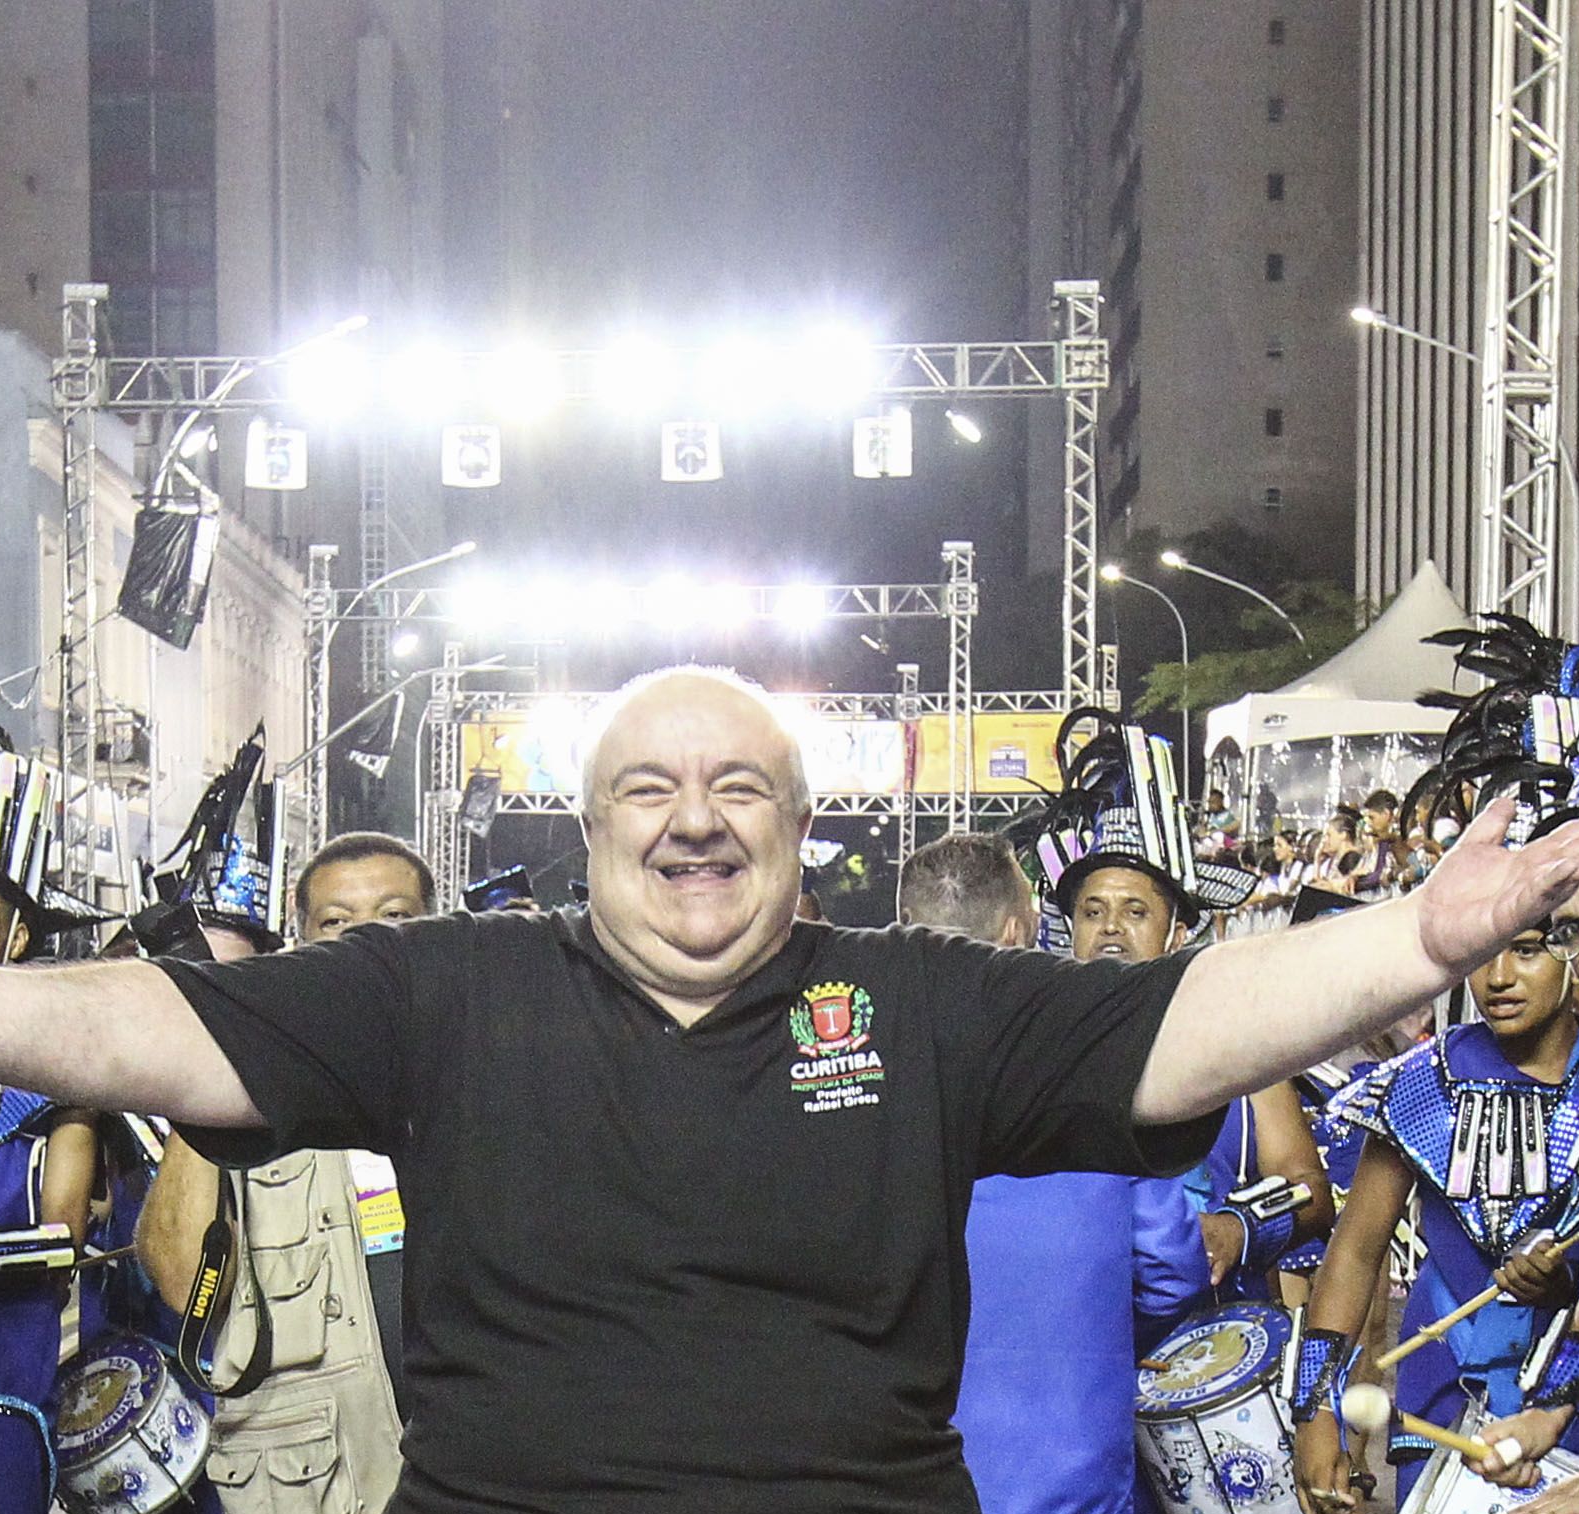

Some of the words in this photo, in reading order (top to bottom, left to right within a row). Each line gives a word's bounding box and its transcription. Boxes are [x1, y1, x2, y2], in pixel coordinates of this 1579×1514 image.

[790, 1050, 882, 1080] CURITIBA
[791, 1079, 840, 1091] PREFEITURA
[842, 1077, 854, 1086] DA
[855, 1072, 884, 1082] CIDADE
[803, 1098, 841, 1113] Rafael
[843, 1093, 880, 1108] Greca
[816, 1085, 864, 1101] Prefeito
[192, 1267, 219, 1318] Nikon
